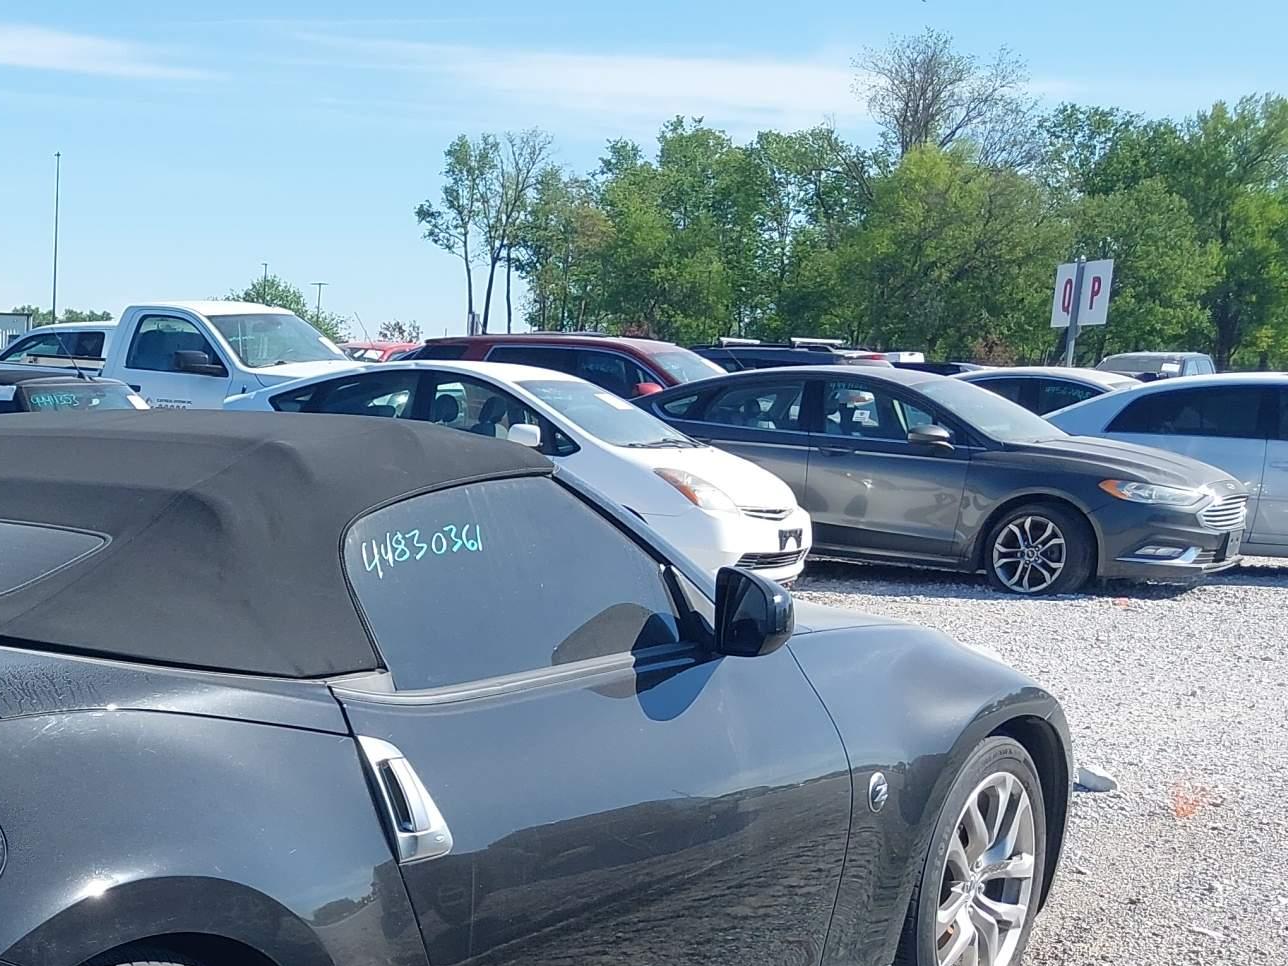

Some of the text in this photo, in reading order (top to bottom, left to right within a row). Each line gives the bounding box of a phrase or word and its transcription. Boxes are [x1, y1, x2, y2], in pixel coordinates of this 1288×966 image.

[1062, 278, 1073, 316] Q
[1088, 275, 1102, 310] P
[361, 523, 483, 580] 44830361
